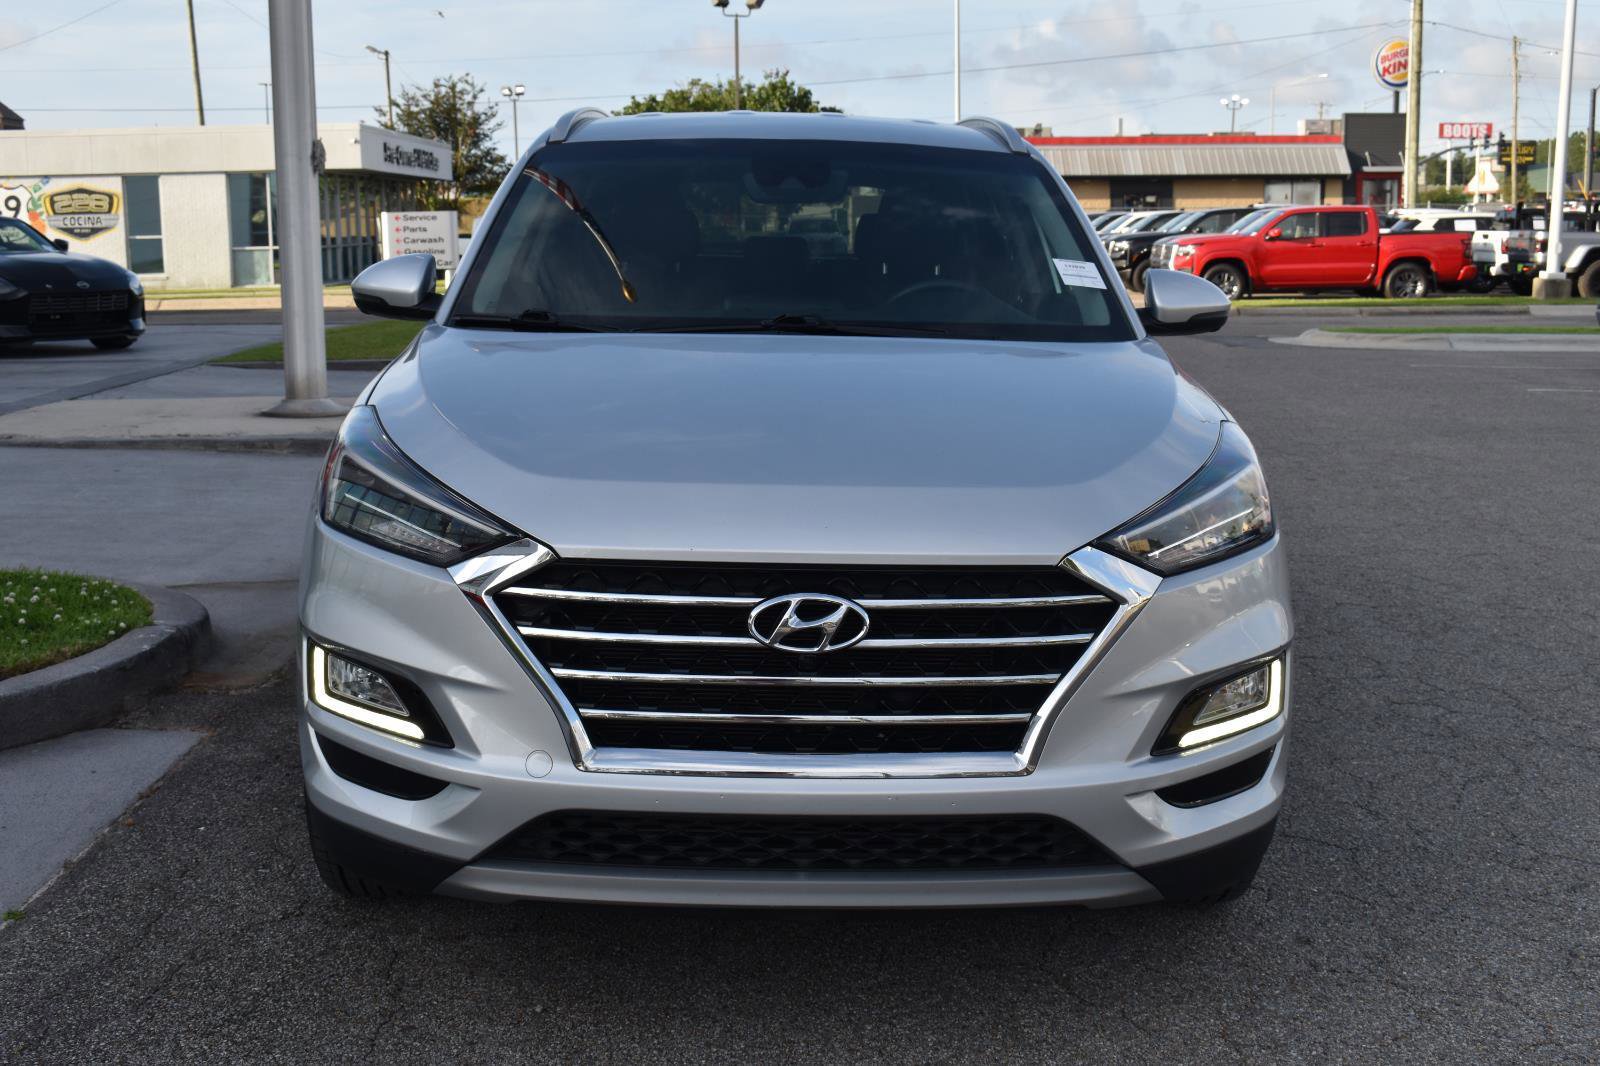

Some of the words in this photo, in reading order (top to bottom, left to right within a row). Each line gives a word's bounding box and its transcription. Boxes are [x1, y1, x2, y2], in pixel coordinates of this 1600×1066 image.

[1380, 47, 1409, 65] BURGE
[1381, 58, 1409, 78] KIN
[1442, 123, 1488, 138] BOOTS
[53, 193, 110, 214] 228
[62, 216, 103, 226] COCINA
[403, 236, 445, 244] Carwash
